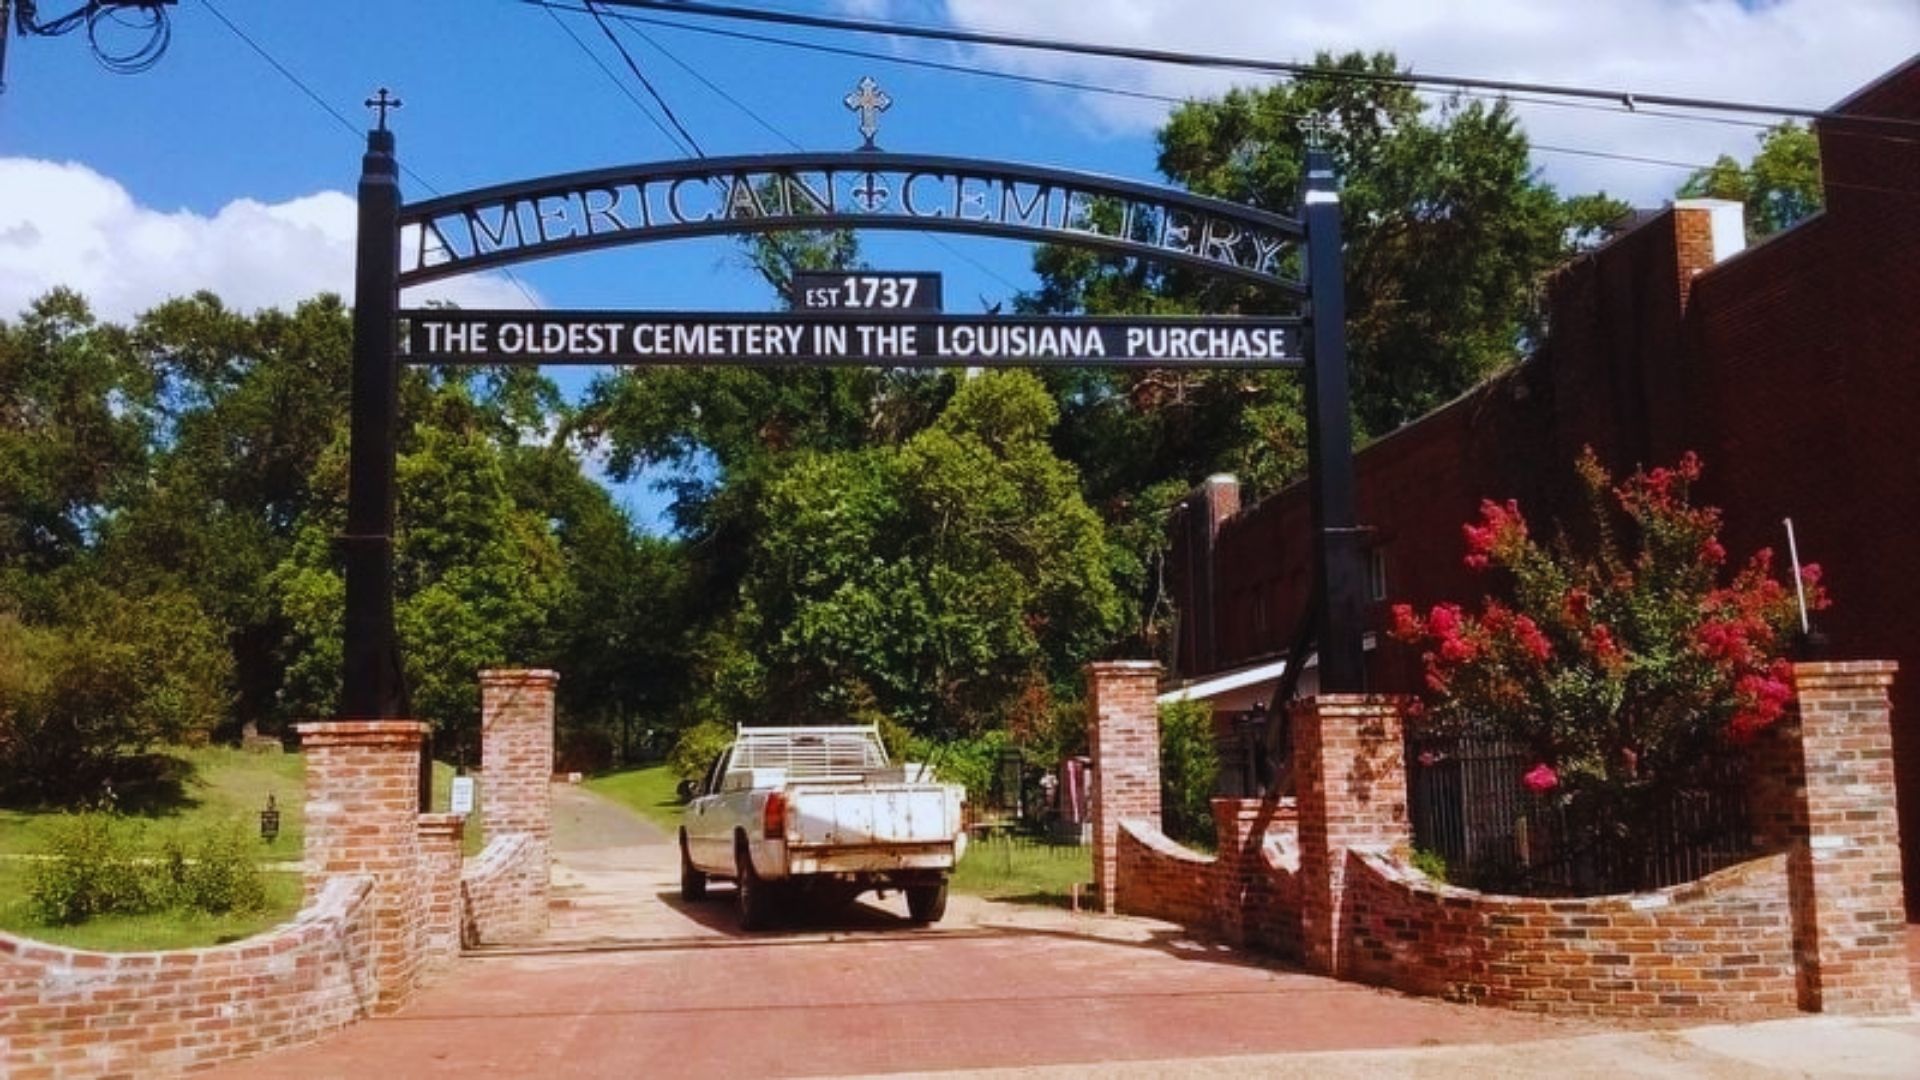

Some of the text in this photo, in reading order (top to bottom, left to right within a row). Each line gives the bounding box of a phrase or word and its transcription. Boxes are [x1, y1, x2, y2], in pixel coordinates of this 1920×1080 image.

[417, 170, 1286, 275] AMERICAN CEMETERY
[805, 277, 918, 309] EST 1737
[423, 322, 1286, 358] THE OLDEST CEMETERY IN THE LOUISIANA PURCHASE
